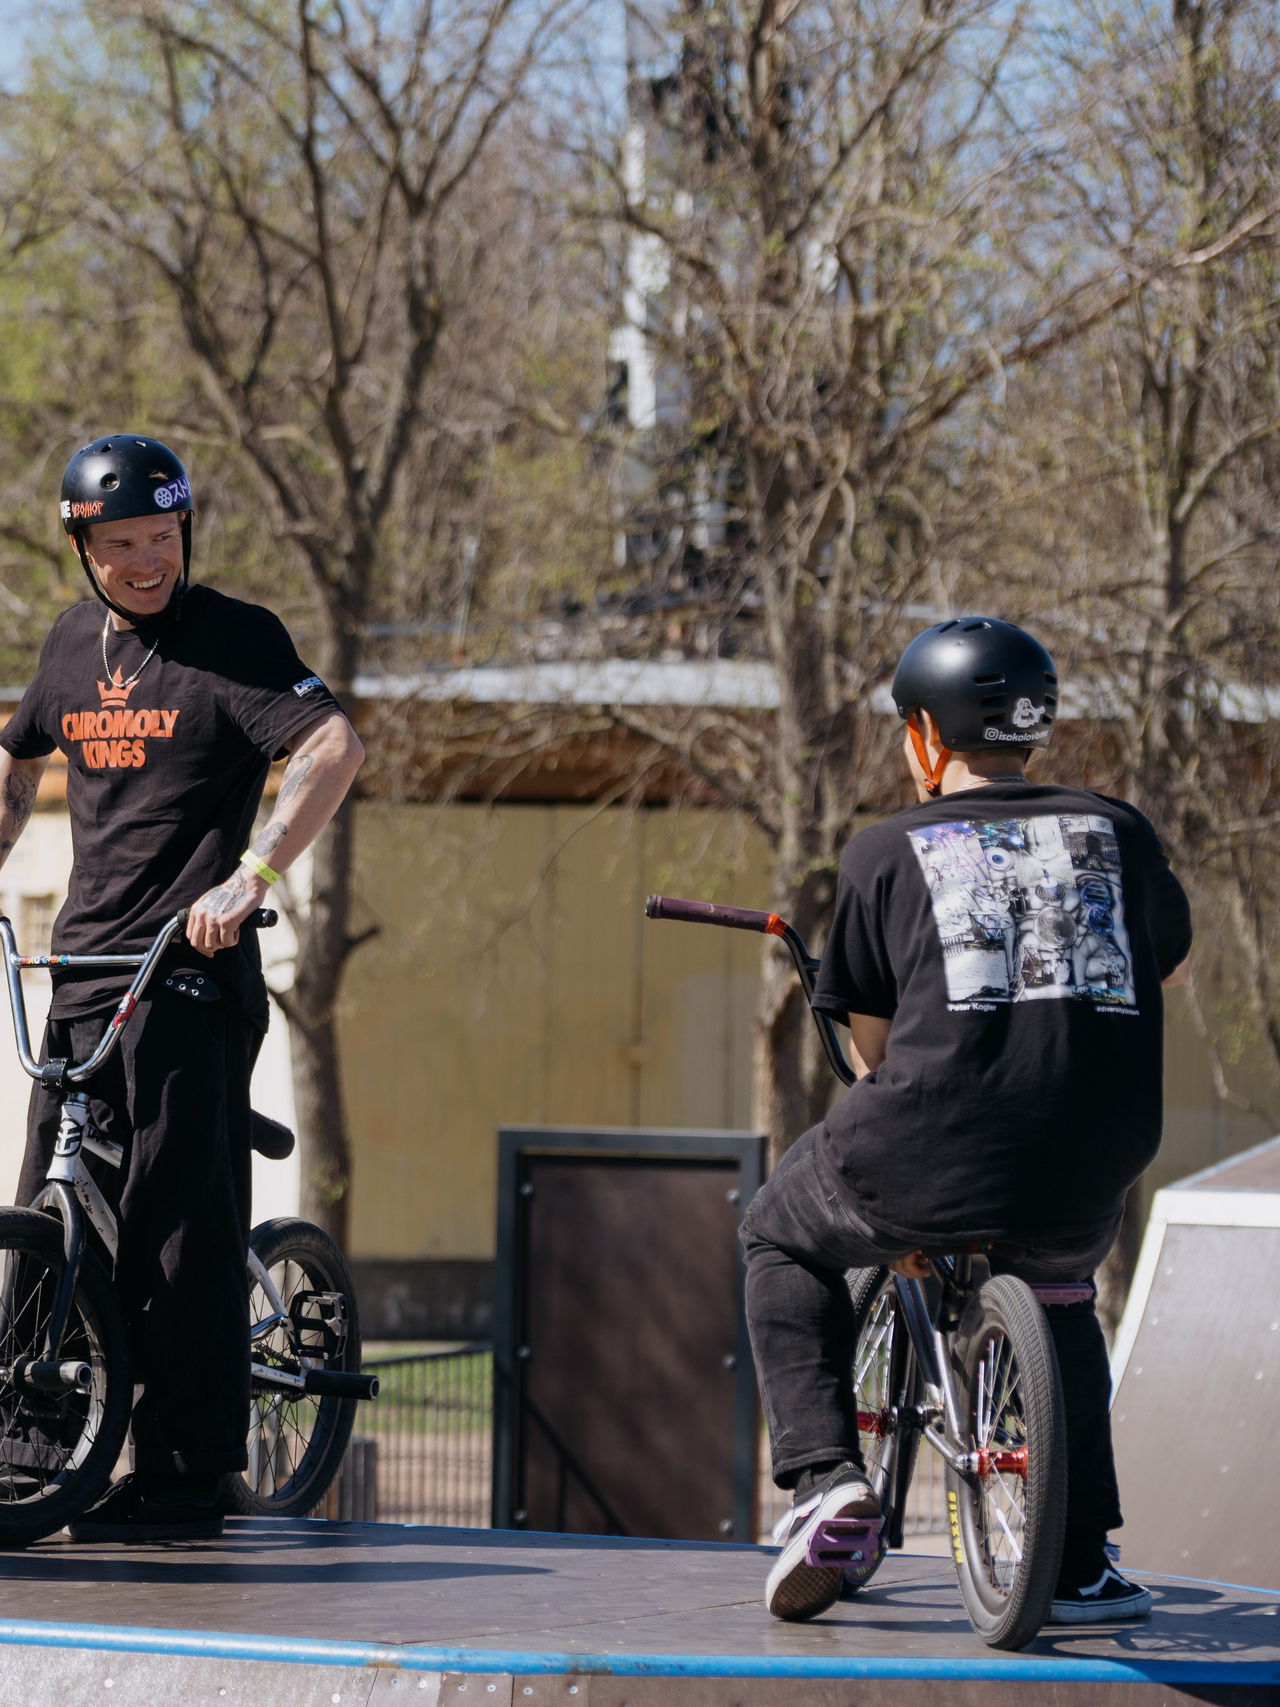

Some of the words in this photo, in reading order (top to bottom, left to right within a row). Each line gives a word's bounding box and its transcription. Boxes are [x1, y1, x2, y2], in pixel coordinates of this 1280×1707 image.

[61, 709, 180, 741] CHROMOLY
[82, 739, 146, 769] KINGS
[947, 1002, 971, 1012] Peter
[972, 1002, 997, 1012] Kogler
[947, 1490, 965, 1564] MAXXIS
